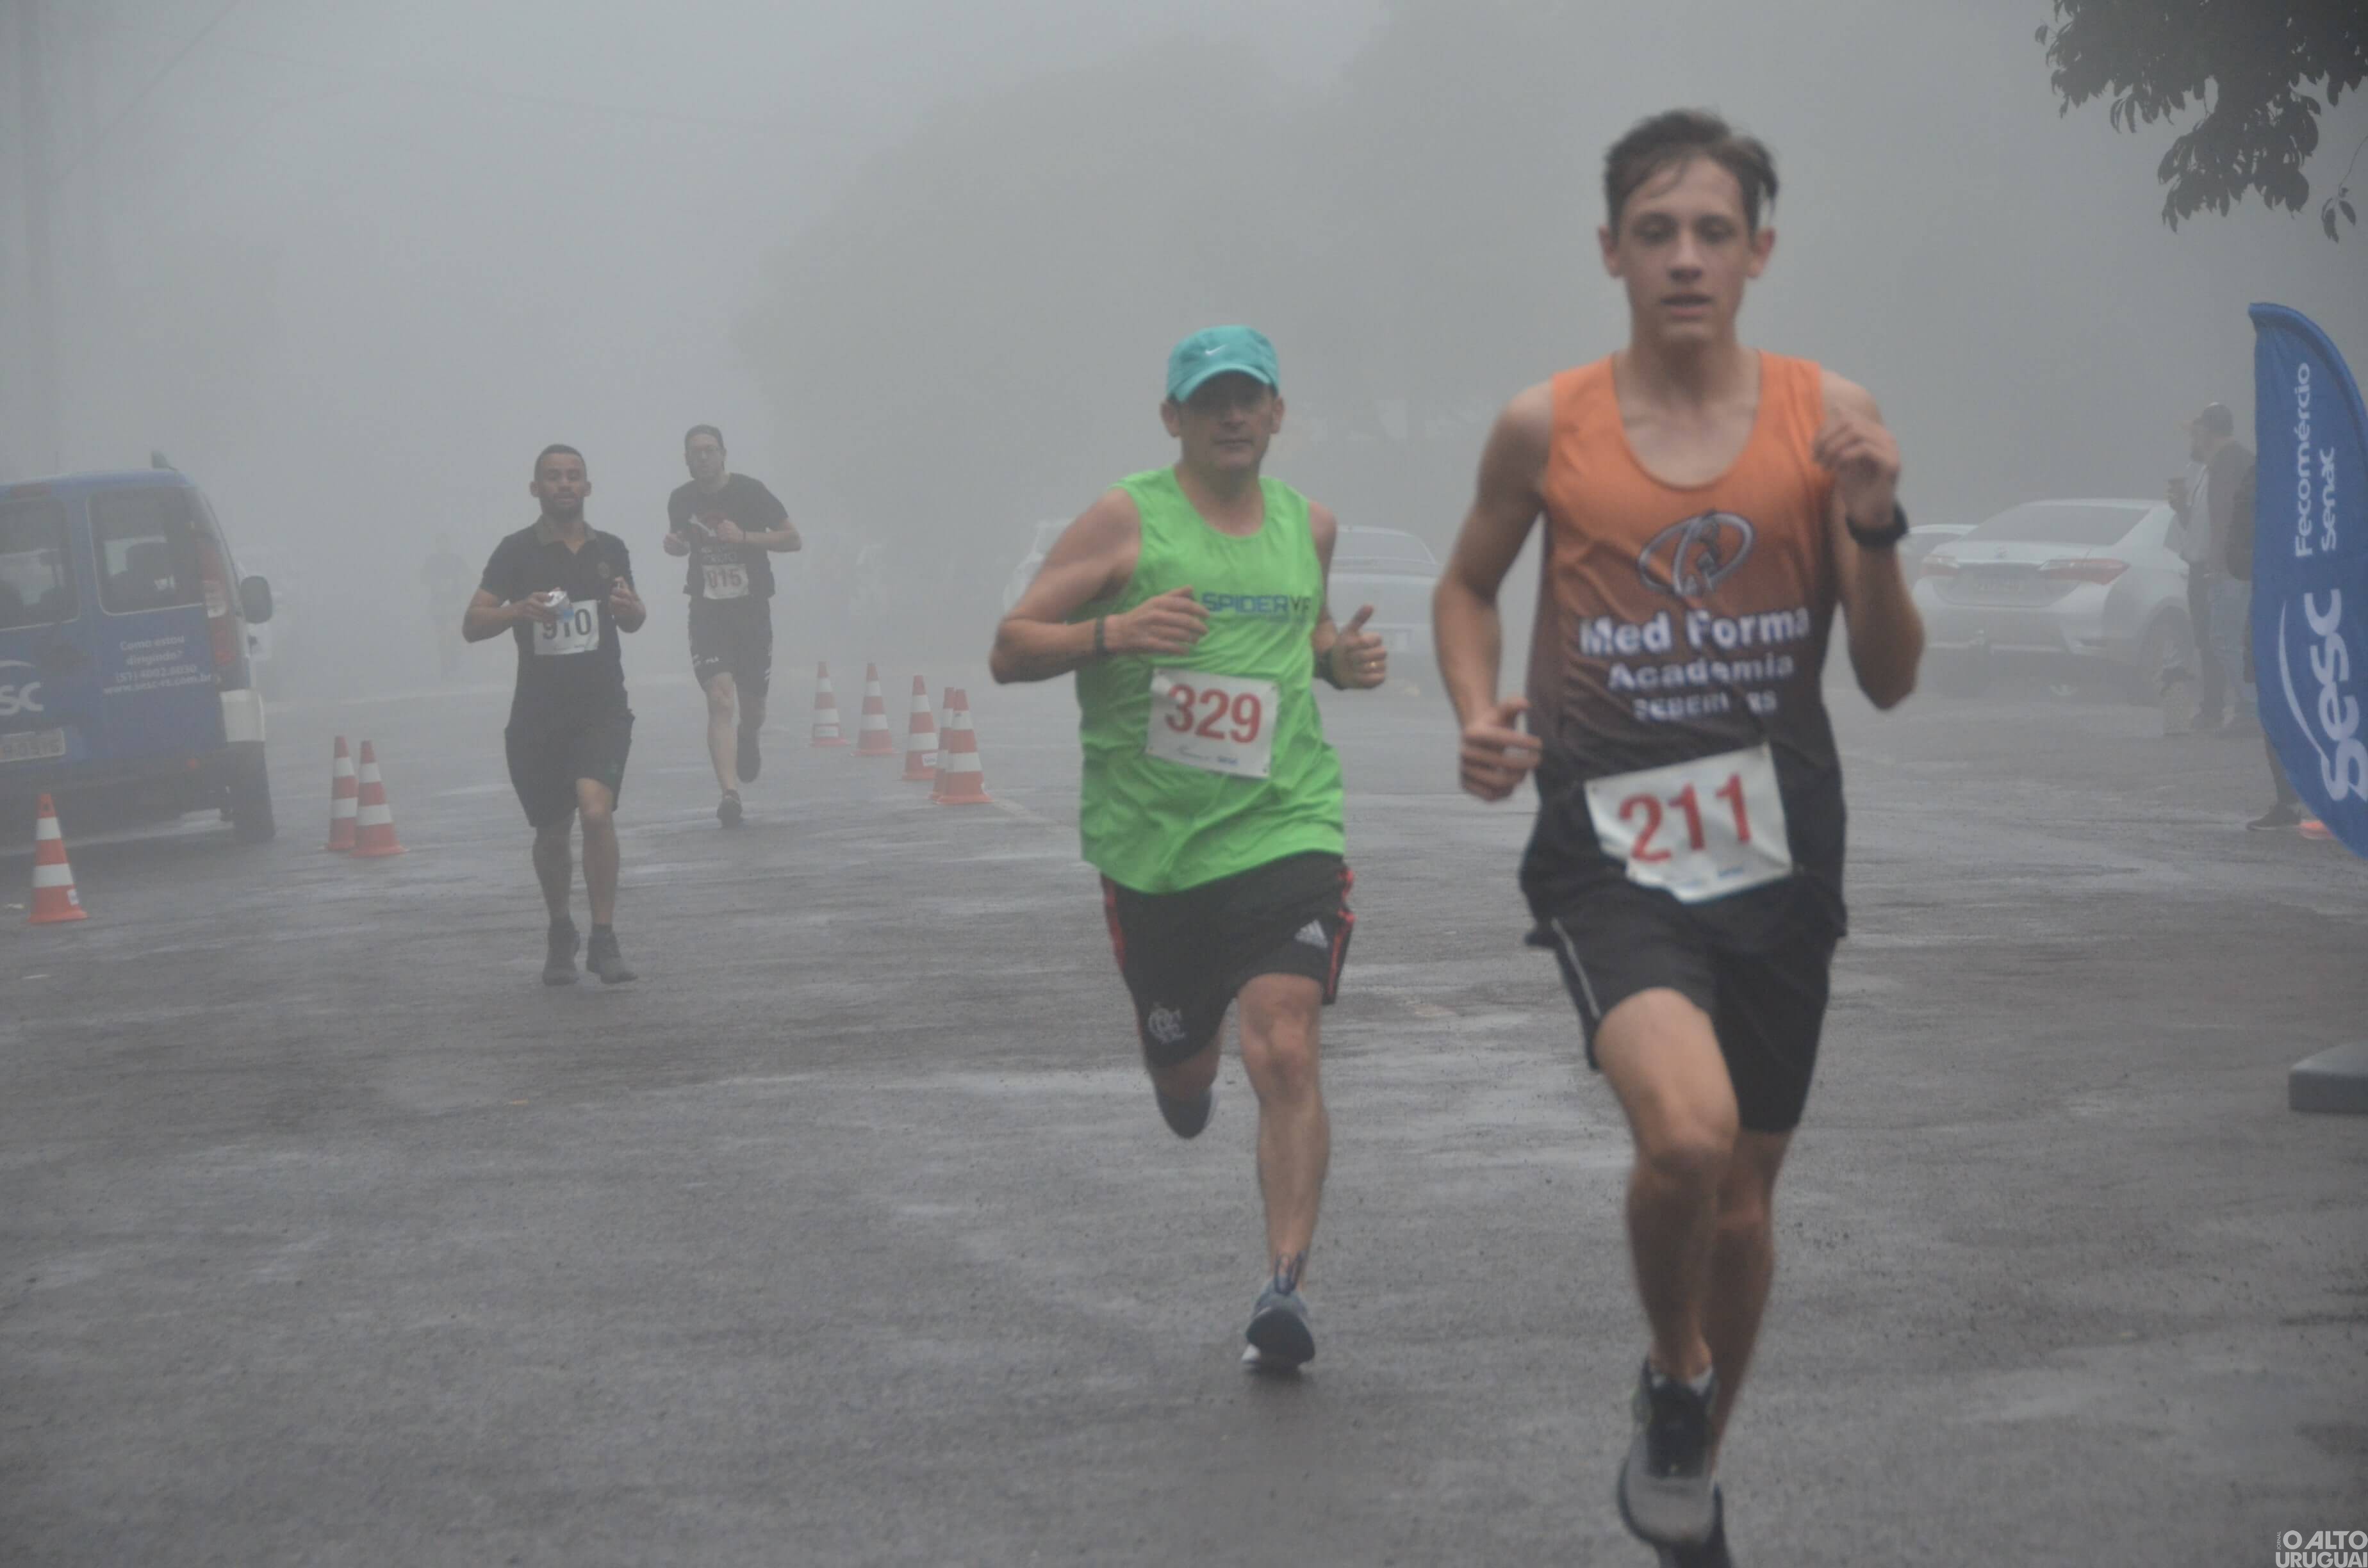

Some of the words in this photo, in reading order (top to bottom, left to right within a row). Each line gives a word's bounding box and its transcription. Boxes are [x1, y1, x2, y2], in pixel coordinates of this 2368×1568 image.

[2294, 362, 2314, 557] Fecomércio
[1579, 612, 1671, 655] Med
[1685, 607, 1810, 649] Forma
[1608, 653, 1795, 691] Academia
[1165, 683, 1262, 744] 329
[1618, 771, 1752, 863] 211
